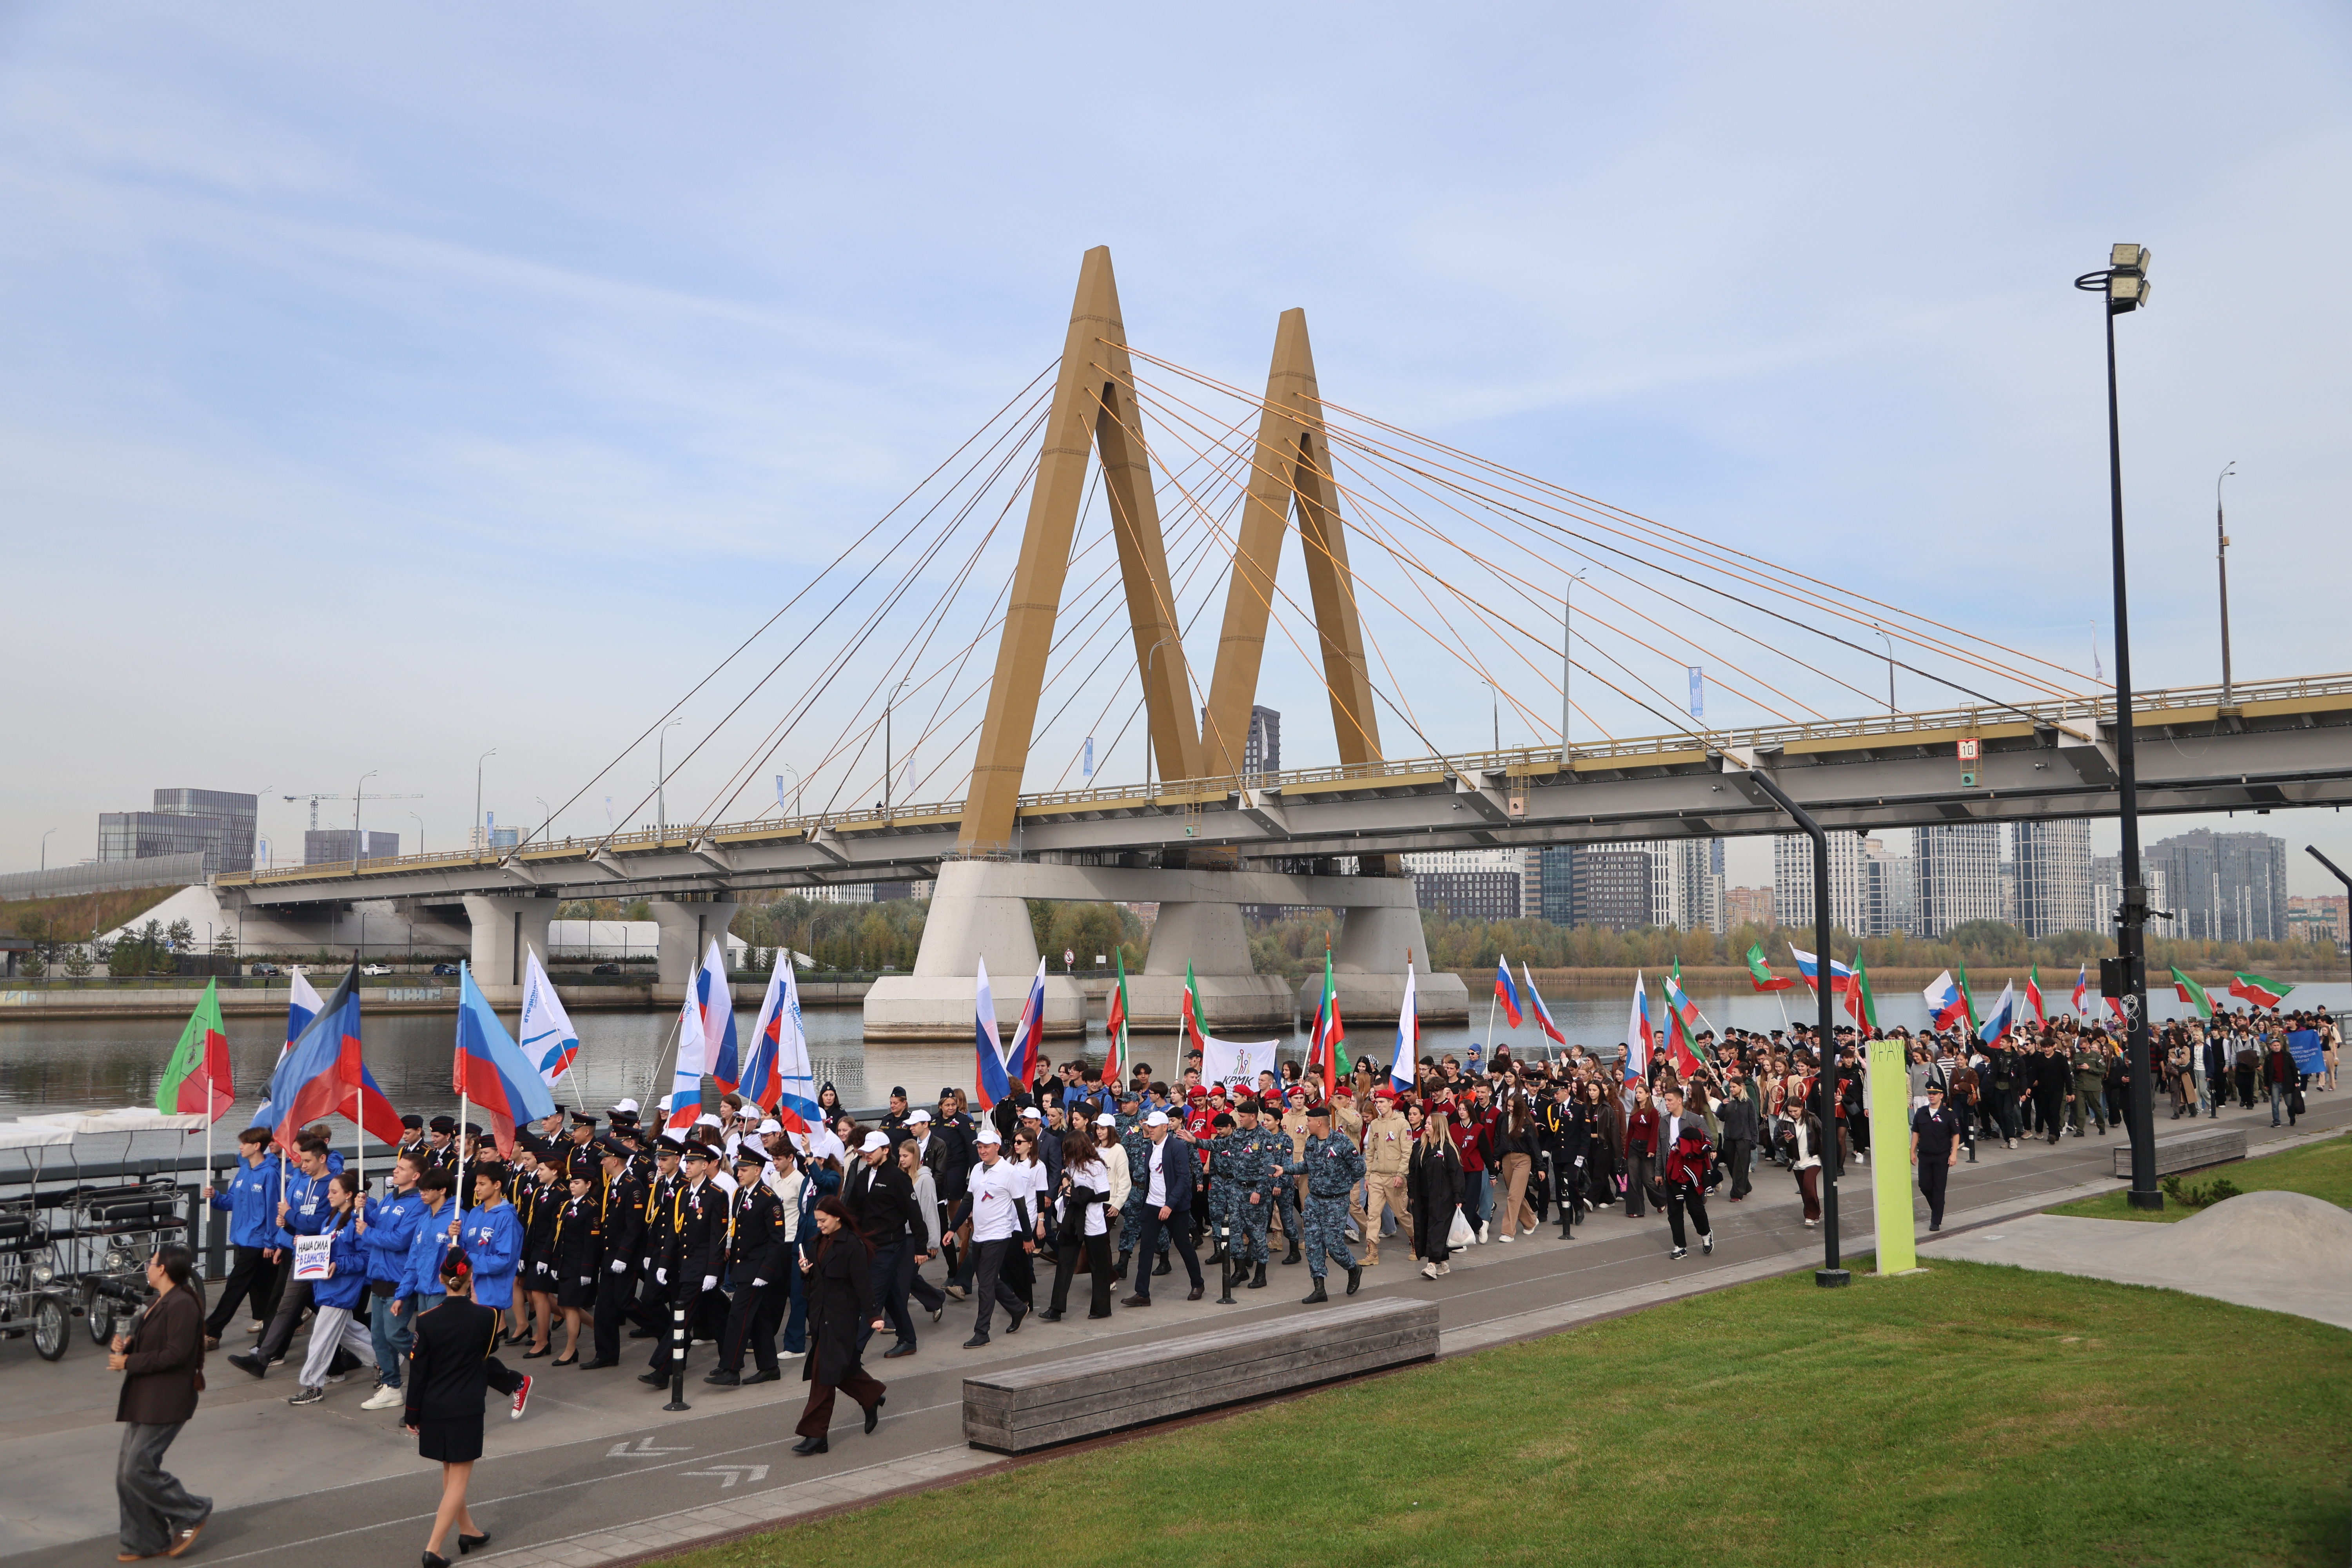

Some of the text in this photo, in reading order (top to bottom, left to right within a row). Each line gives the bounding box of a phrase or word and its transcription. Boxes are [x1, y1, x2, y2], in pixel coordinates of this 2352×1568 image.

[1962, 745, 1973, 755] 10
[1869, 1040, 1904, 1062] УРАМ
[1223, 1076, 1254, 1086] КРМК
[299, 1240, 328, 1254] НАША СИЛА
[300, 1252, 326, 1265] В ЕДИНСТВЕ
